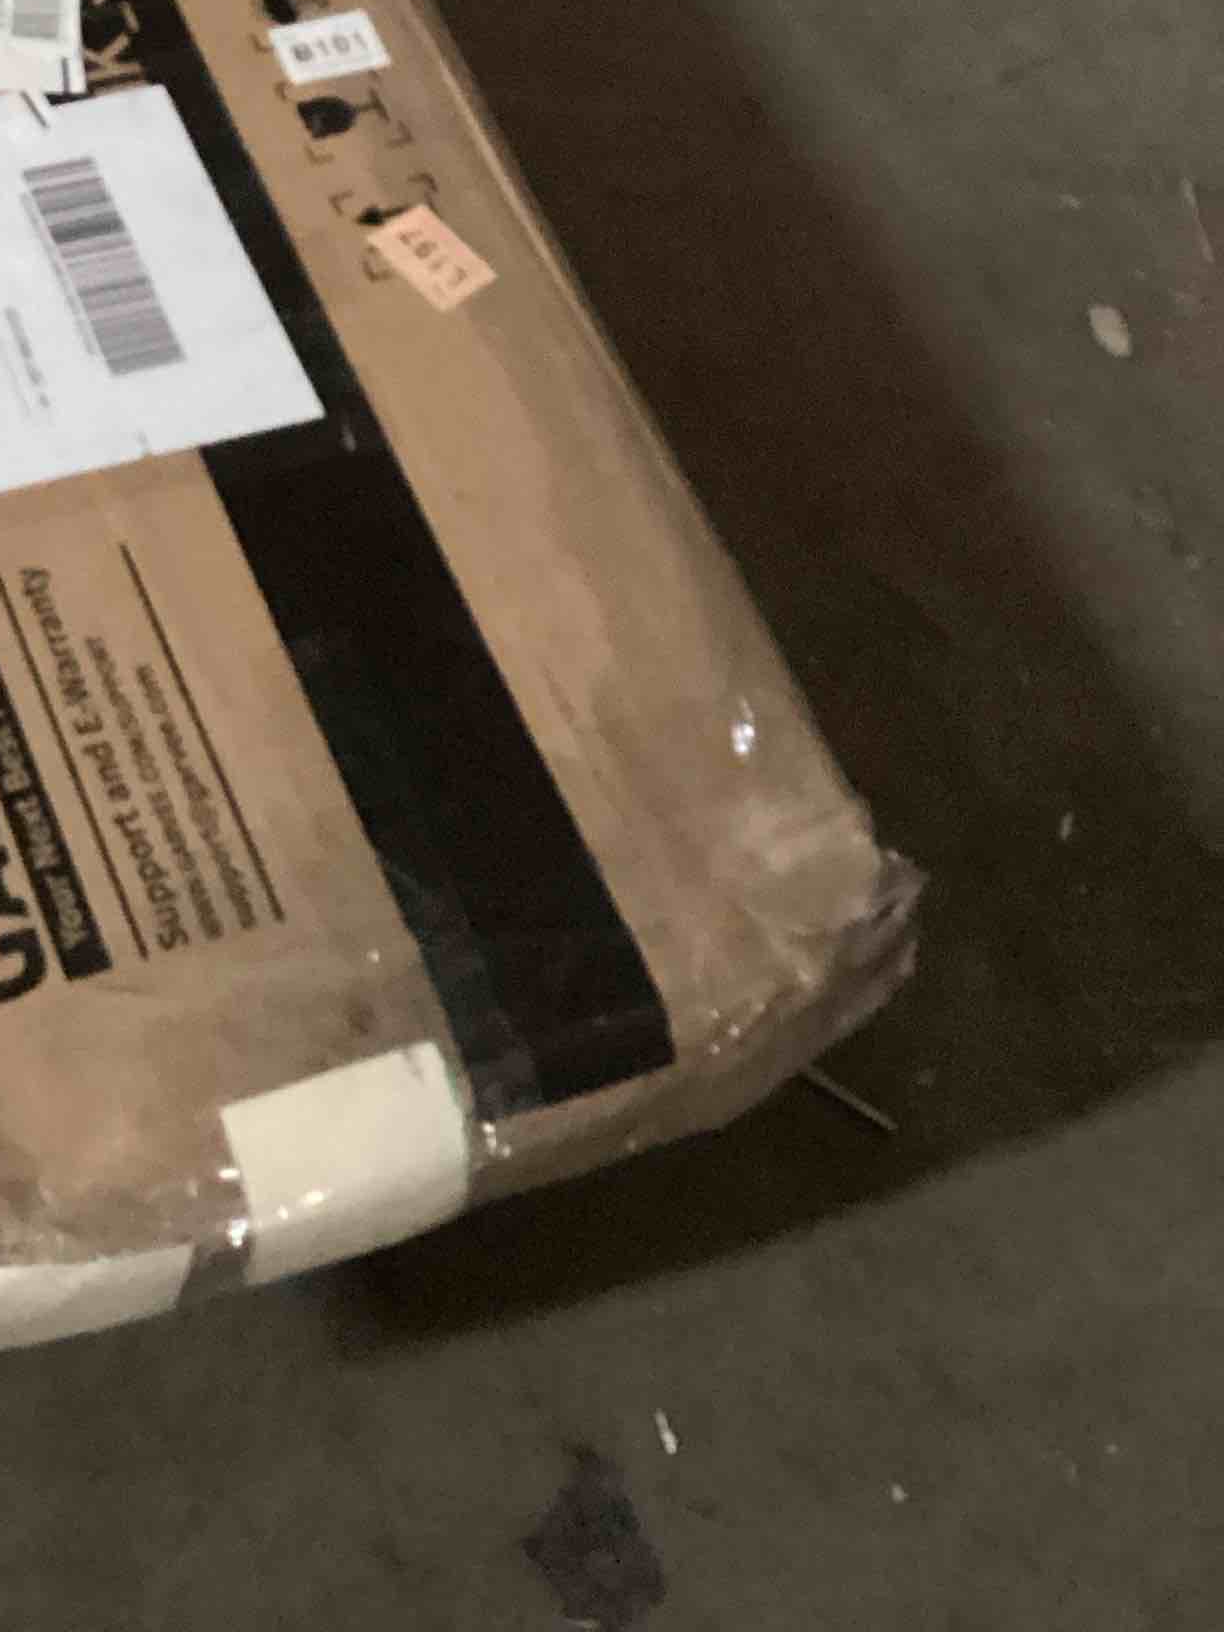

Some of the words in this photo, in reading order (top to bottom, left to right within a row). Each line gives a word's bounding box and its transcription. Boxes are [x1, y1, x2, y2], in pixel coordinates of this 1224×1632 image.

[20, 567, 103, 736] E-Warranty
[80, 739, 132, 803] and
[14, 794, 64, 869] Next
[43, 874, 89, 950] Your
[112, 808, 191, 951] Support
